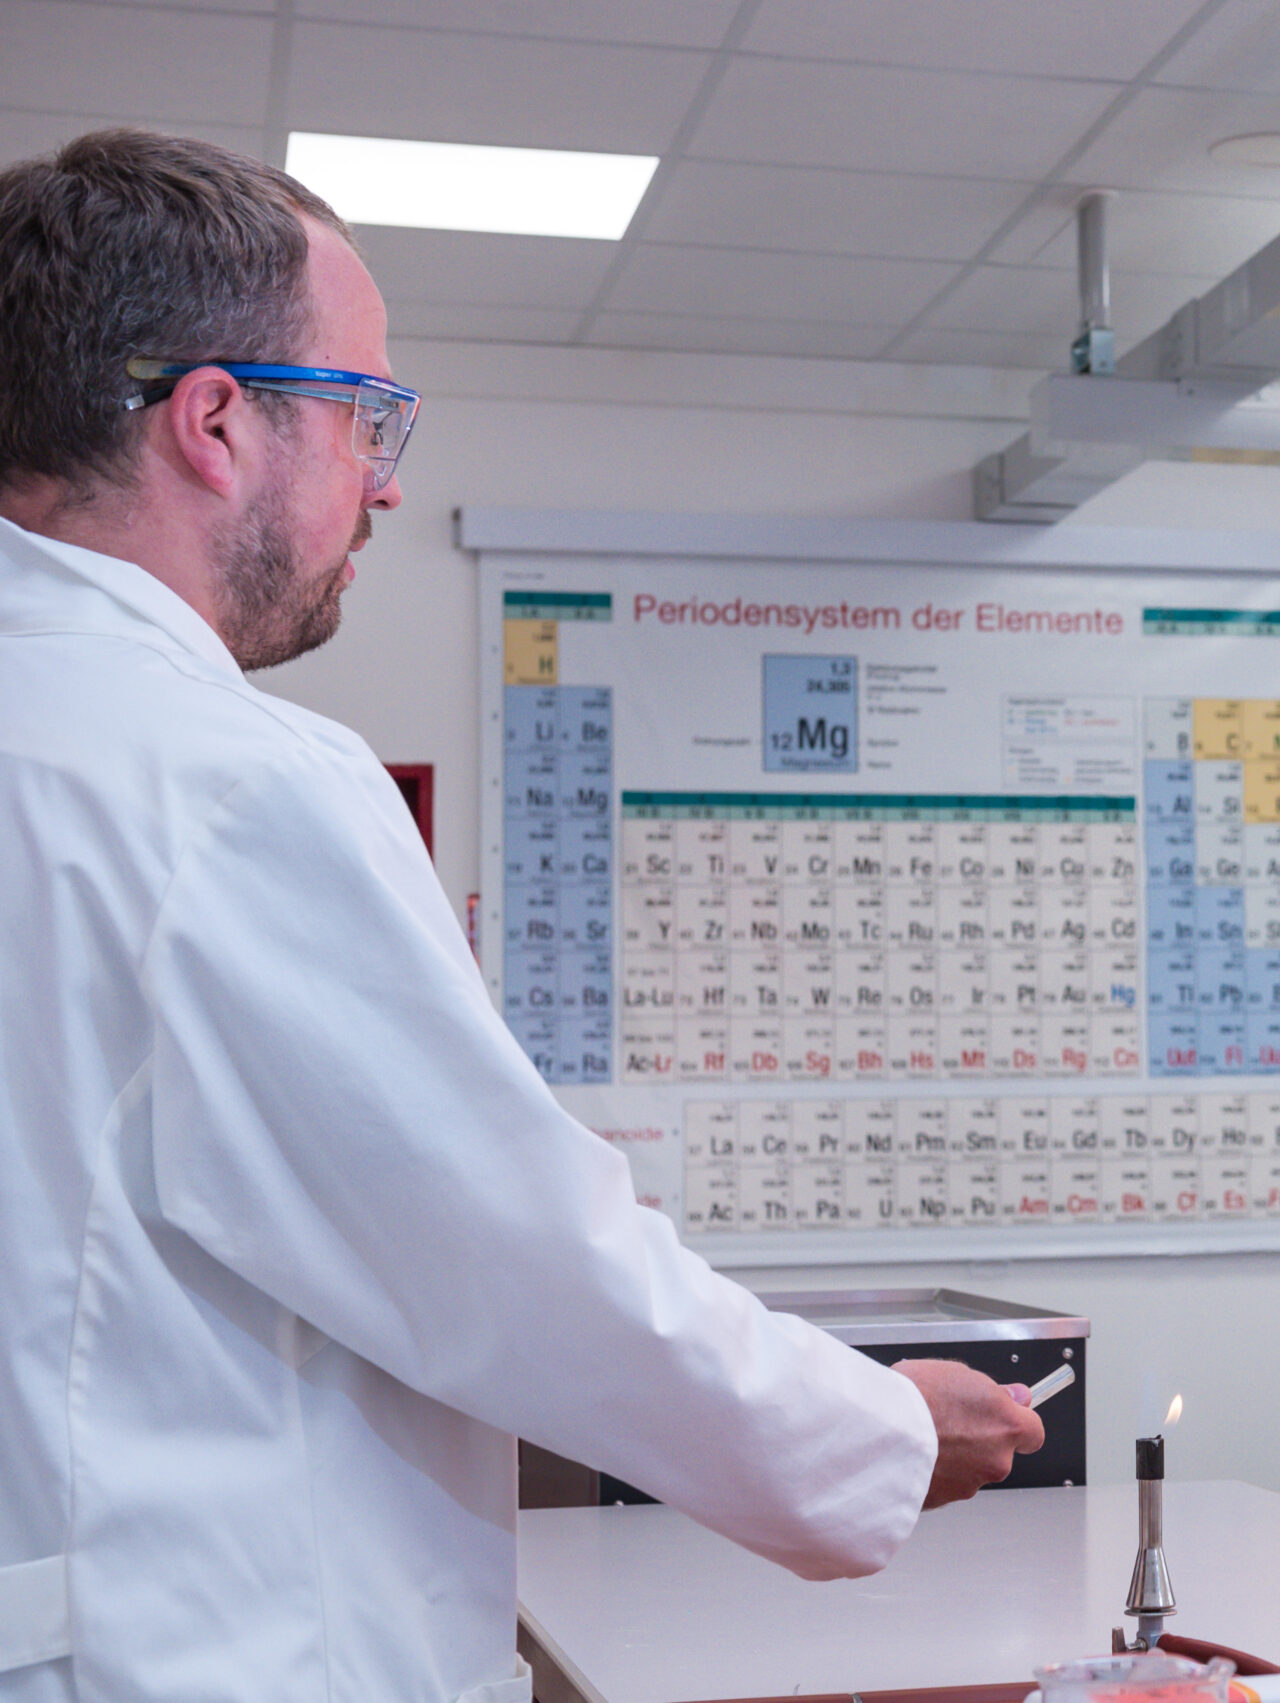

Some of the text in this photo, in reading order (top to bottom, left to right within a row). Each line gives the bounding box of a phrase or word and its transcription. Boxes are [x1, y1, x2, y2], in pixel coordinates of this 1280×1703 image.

[633, 593, 901, 634] Periodensystem
[912, 601, 966, 630] der
[975, 603, 1123, 635] Elemente
[539, 656, 553, 674] H
[536, 721, 554, 742] Li
[583, 721, 607, 742] Be
[771, 715, 849, 759] 12 Mg
[1178, 733, 1188, 751] B
[1226, 733, 1238, 751] C
[527, 788, 553, 808] Na
[578, 788, 607, 813] Mg
[1173, 795, 1192, 815] Al
[1223, 796, 1239, 815] Si
[541, 855, 553, 873] K
[583, 856, 608, 874] Ca
[647, 856, 671, 874] Sc
[709, 856, 724, 874] Ti
[765, 856, 777, 874] V
[809, 856, 828, 874] Cr
[854, 857, 881, 875] Mn
[911, 858, 932, 875] Fe
[960, 859, 984, 877] Co
[1017, 859, 1034, 876] Ni
[1061, 859, 1084, 876] Cu
[1112, 858, 1133, 876] Zn
[1170, 859, 1193, 877] Ga
[1217, 859, 1240, 877] Ge
[528, 922, 553, 940] Rb
[587, 922, 607, 940] Sr
[659, 922, 671, 939] Y
[705, 922, 723, 939] Zr
[751, 922, 777, 940] Nb
[802, 922, 829, 940] Mo
[861, 922, 881, 940] Tc
[910, 922, 933, 940] Ru
[960, 922, 984, 939] Rh
[1012, 921, 1034, 939] Pd
[1062, 920, 1085, 942] Ag
[1112, 920, 1135, 938] Cd
[1176, 920, 1192, 938] In
[1218, 920, 1242, 939] Sn
[530, 988, 553, 1006] Cs
[583, 988, 607, 1006] Ba
[704, 987, 725, 1005] Hf
[758, 987, 777, 1005] Ta
[812, 987, 829, 1004] W
[858, 988, 882, 1005] Re
[910, 987, 933, 1005] Os
[972, 986, 984, 1003] Ir
[1018, 985, 1035, 1002] Pt
[1062, 984, 1085, 1001] Au
[1111, 983, 1135, 1006] Hg
[1178, 983, 1193, 1001] Tl
[1219, 983, 1242, 1001] Pb
[535, 1054, 553, 1073] Fr
[582, 1054, 607, 1073] Ra
[628, 1053, 671, 1072] Ac-Lr
[704, 1052, 725, 1070] Rf
[753, 1052, 777, 1070] Db
[806, 1052, 830, 1075] Sg
[858, 1051, 882, 1069] Bh
[910, 1051, 933, 1069] Hs
[960, 1049, 985, 1067] Mt
[1014, 1049, 1035, 1066] Ds
[1063, 1049, 1086, 1071] Rg
[1114, 1048, 1138, 1066] Cn
[763, 1135, 786, 1154] Ce
[820, 1135, 838, 1153] Pr
[867, 1134, 891, 1153] Nd
[917, 1133, 945, 1151] Pm
[967, 1131, 995, 1150] Sm
[1024, 1130, 1047, 1150] Eu
[1073, 1129, 1097, 1149] Gd
[1127, 1129, 1146, 1148] Tb
[1173, 1128, 1195, 1152] Dy
[1222, 1127, 1245, 1145] Ho
[710, 1136, 733, 1155] La
[879, 1199, 892, 1218] U
[972, 1197, 995, 1215] Pu
[1020, 1195, 1048, 1214] Am
[1068, 1194, 1097, 1213] Cm
[1224, 1191, 1245, 1209] Es
[709, 1202, 732, 1222] Ac
[765, 1201, 786, 1220] Th
[817, 1200, 840, 1219] Pa
[921, 1198, 945, 1222] Np
